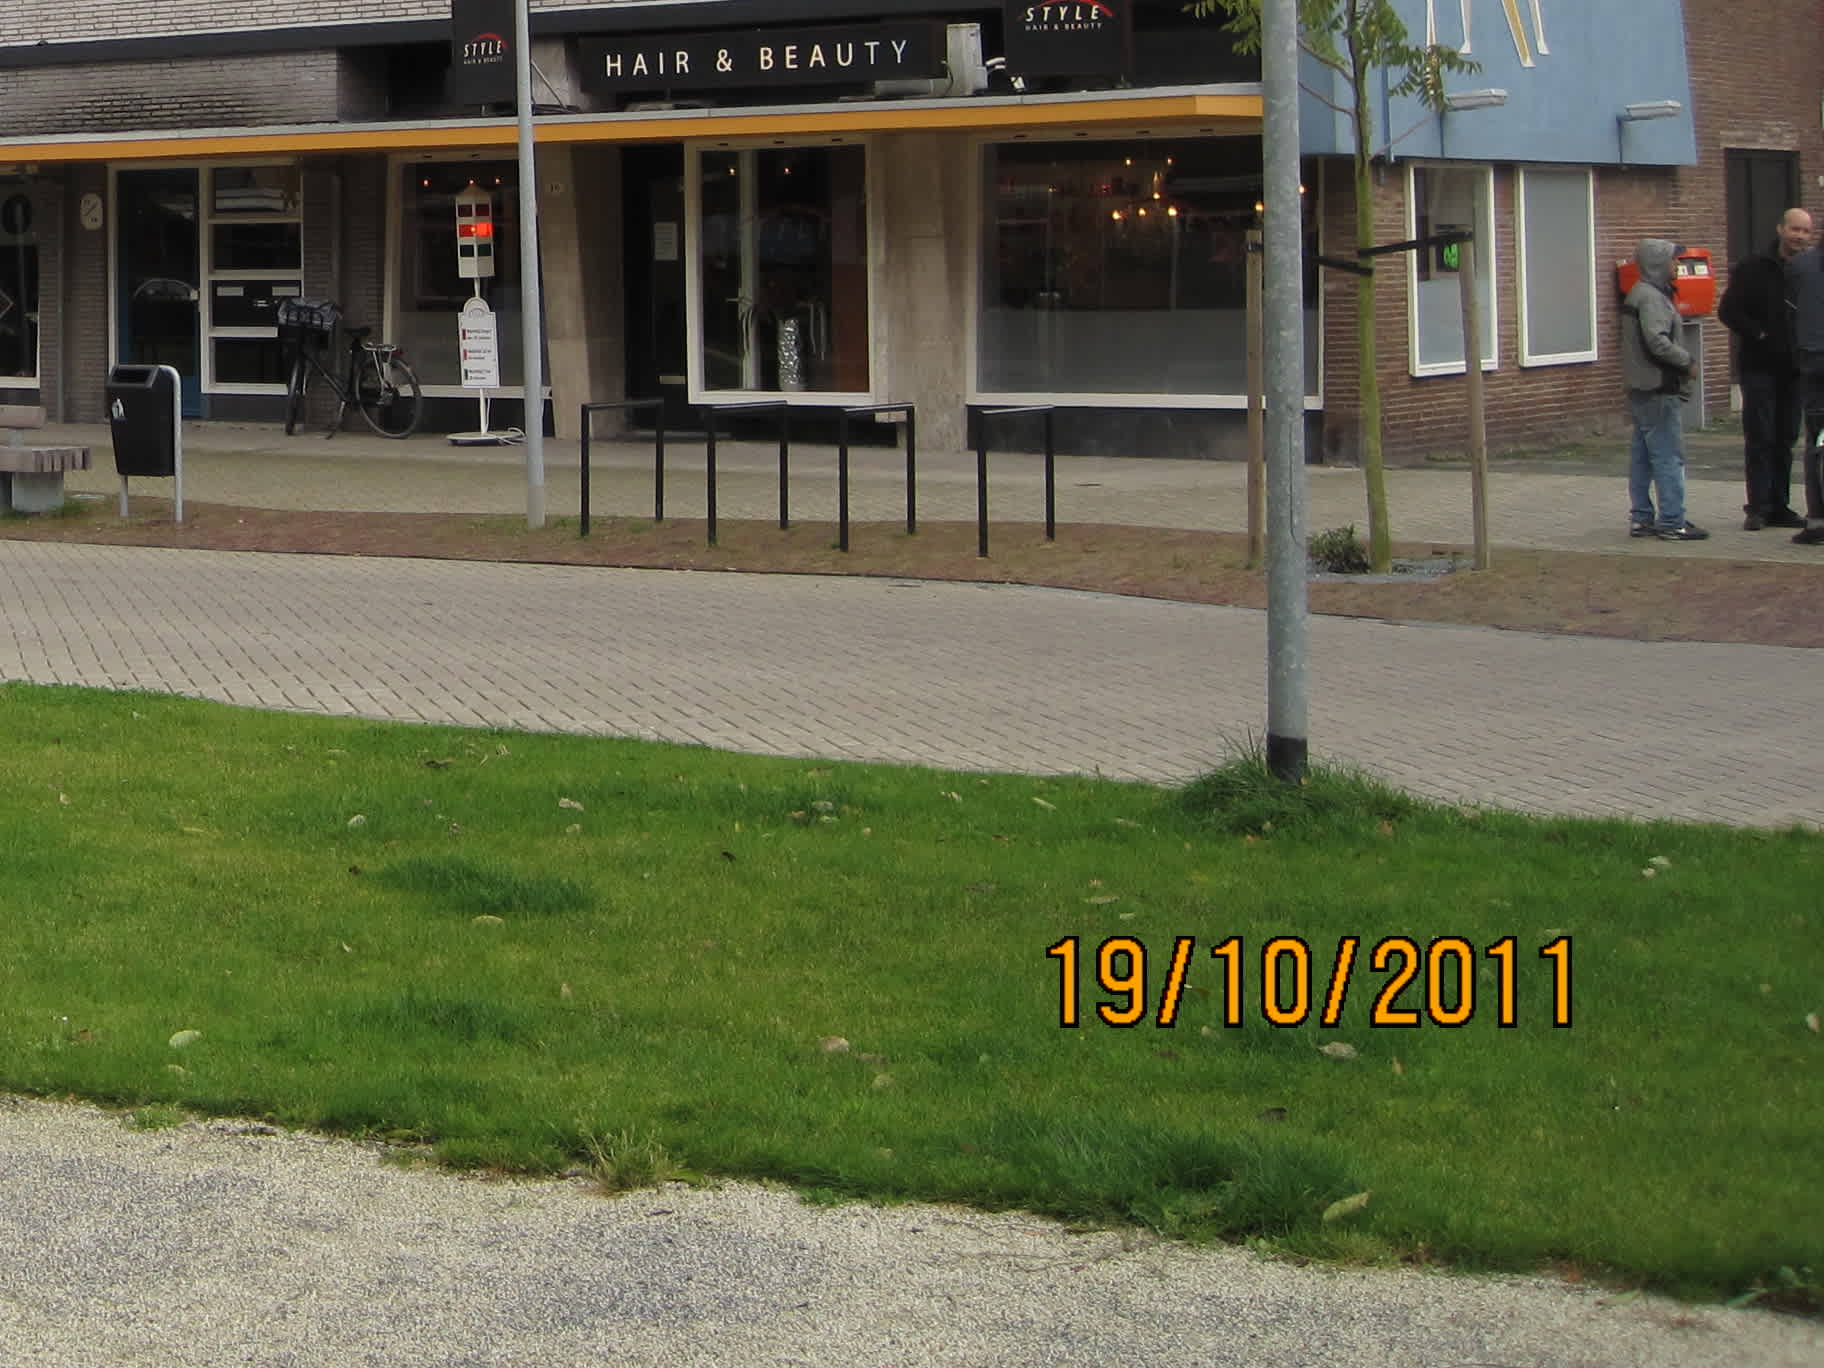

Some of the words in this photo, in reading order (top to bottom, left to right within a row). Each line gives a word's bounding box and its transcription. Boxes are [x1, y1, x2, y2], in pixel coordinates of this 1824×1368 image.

[1025, 5, 1100, 22] STYLE
[463, 40, 502, 57] STYLE
[606, 51, 689, 77] HAIR
[716, 48, 732, 72] &
[759, 40, 907, 70] BEAUTY
